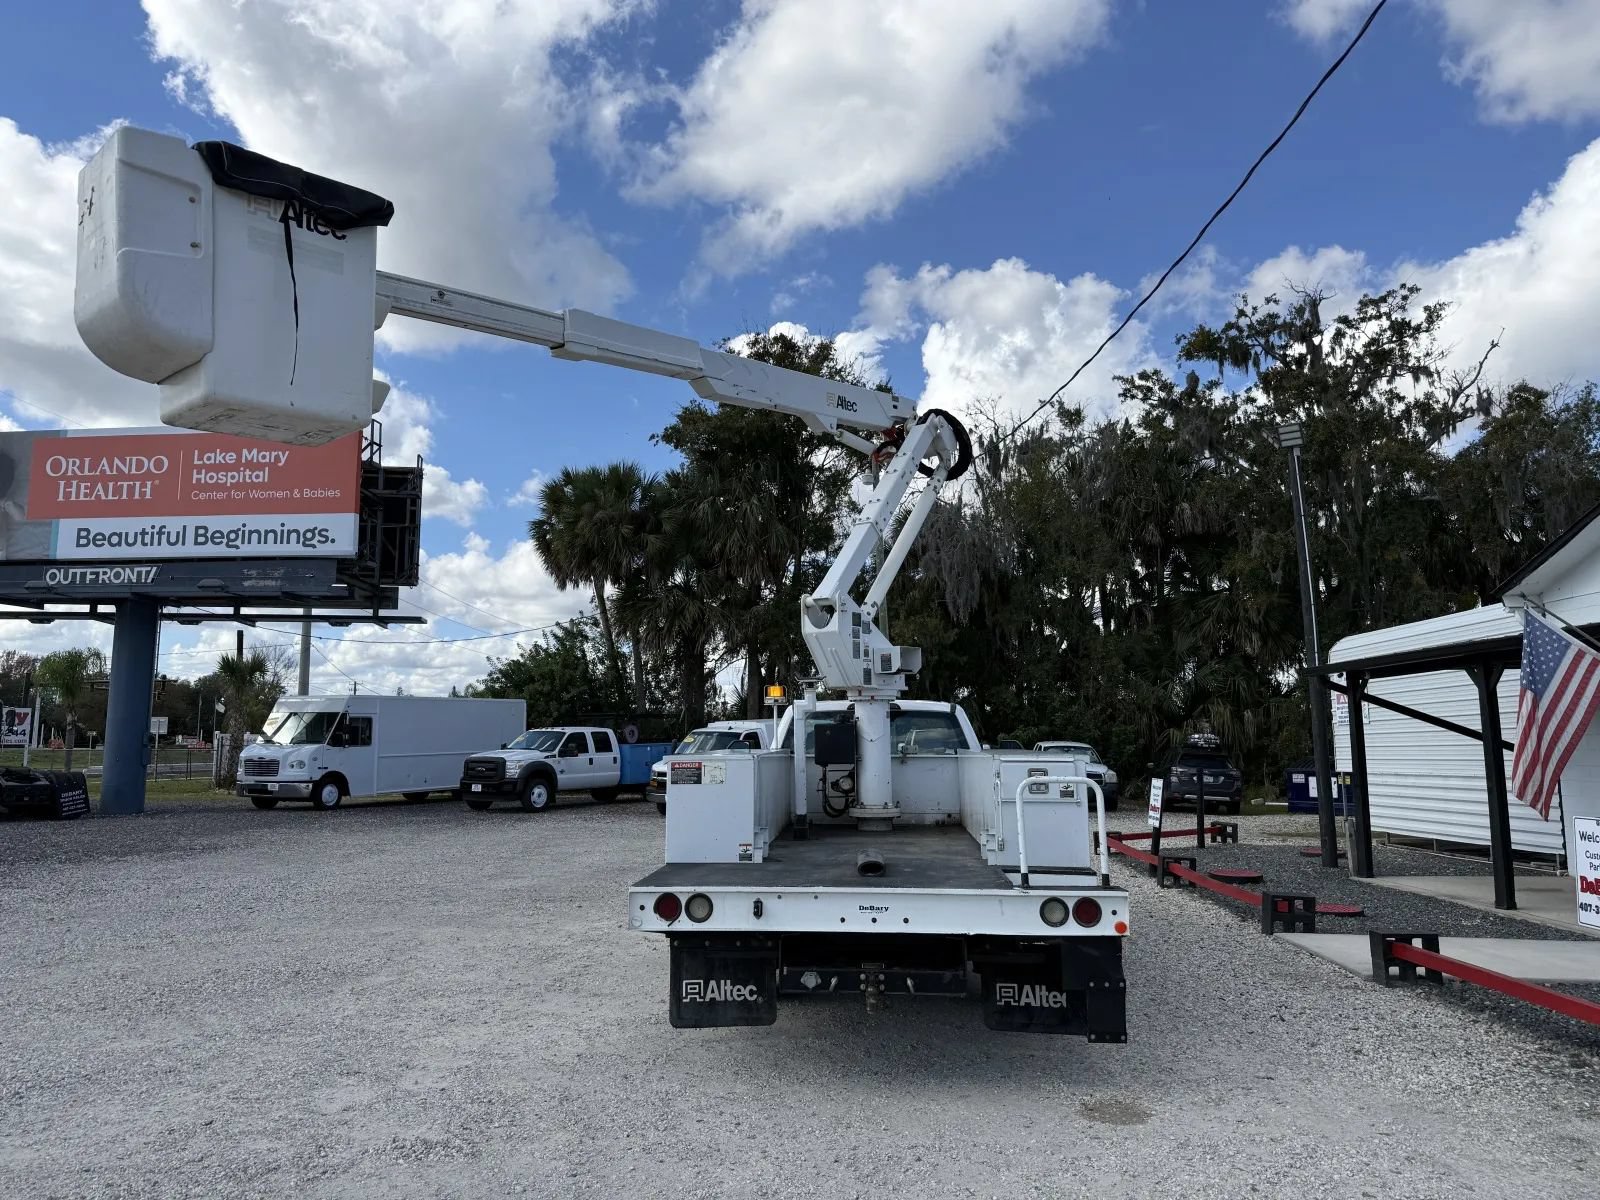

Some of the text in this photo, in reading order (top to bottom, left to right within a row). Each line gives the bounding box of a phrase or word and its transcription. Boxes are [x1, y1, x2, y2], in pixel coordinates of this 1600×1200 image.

[836, 395, 858, 412] Altec
[45, 455, 169, 477] ORLANDO
[193, 448, 290, 467] Lake Mary
[192, 467, 269, 487] Hospital
[56, 480, 153, 502] HEALTH
[191, 487, 341, 500] Center for Women & Babies
[75, 523, 336, 550] Beautiful Beginnings.
[704, 979, 758, 1002] Altec
